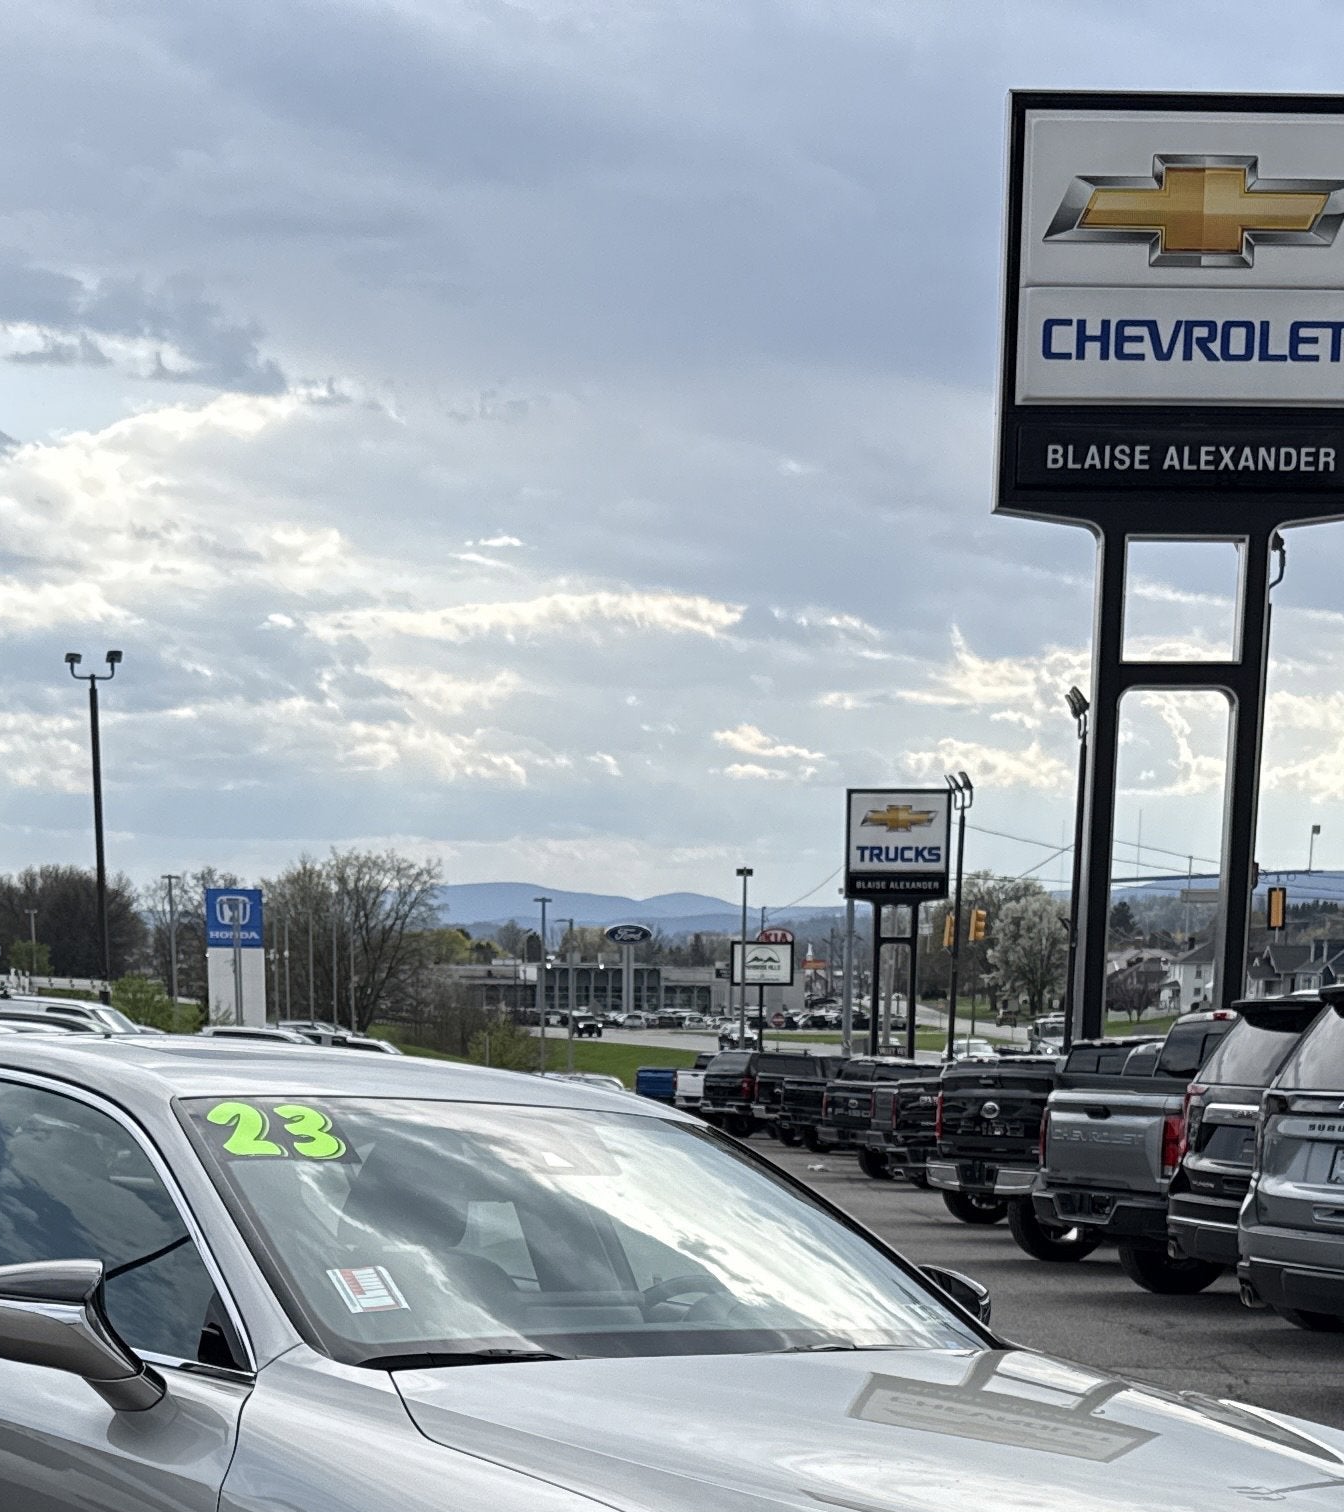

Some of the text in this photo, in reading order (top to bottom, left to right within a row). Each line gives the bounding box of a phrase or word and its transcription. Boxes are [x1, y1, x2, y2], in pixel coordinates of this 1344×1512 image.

[1046, 444, 1337, 473] BLAISE ALEXANDER
[856, 846, 941, 863] TRUCKS
[856, 881, 940, 890] BLAISE ALEXANDER
[614, 928, 644, 941] Ford
[763, 933, 788, 942] KIA
[207, 1101, 347, 1160] 23
[1052, 1128, 1145, 1145] CHEVROLET
